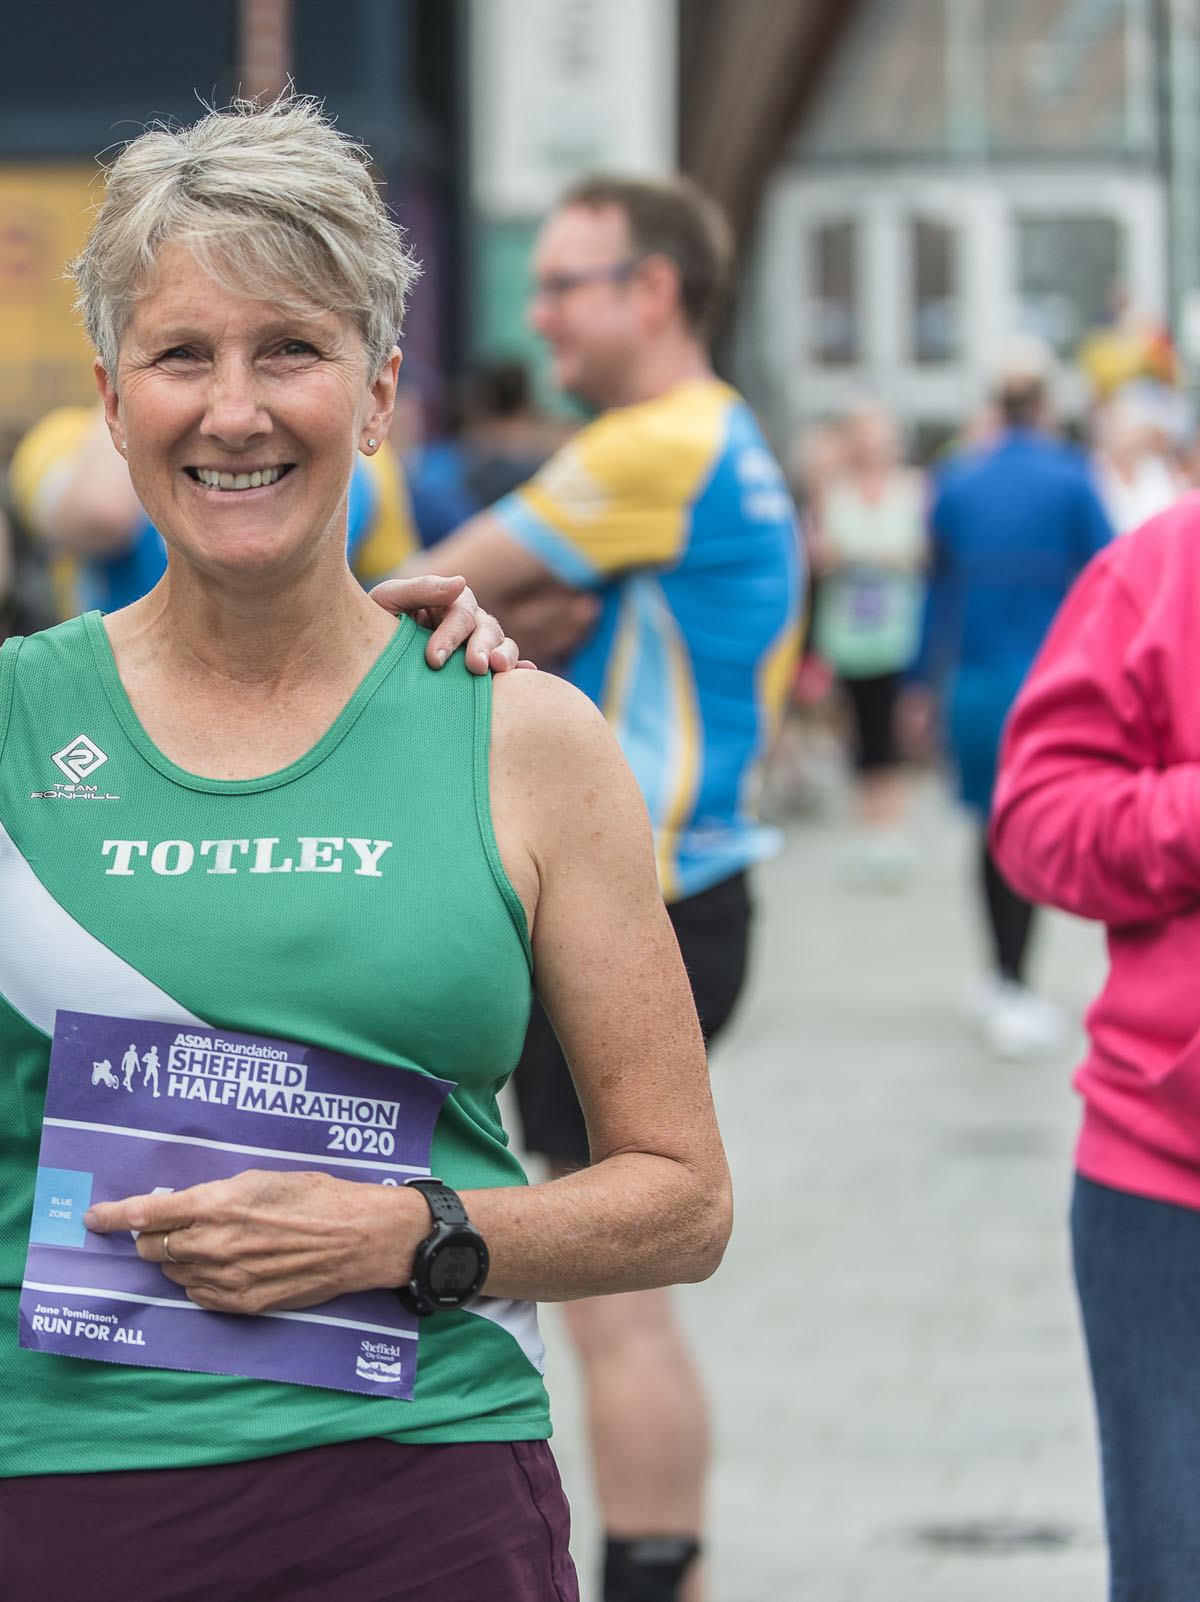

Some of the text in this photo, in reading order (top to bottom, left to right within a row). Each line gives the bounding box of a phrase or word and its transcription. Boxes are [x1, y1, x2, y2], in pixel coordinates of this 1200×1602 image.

[30, 790, 121, 800] RONHILL
[52, 783, 98, 792] TEAM
[101, 837, 393, 877] TOTLEY
[174, 1033, 289, 1062] ASDA Foundation
[171, 1048, 304, 1088] SHEFFIELD
[167, 1074, 396, 1127] HALF MARATHON
[326, 1125, 395, 1157] 2020
[50, 1196, 73, 1207] BLUE
[48, 1209, 72, 1220] ZONE
[35, 1304, 119, 1325] Jane Tomlinson's
[32, 1315, 146, 1346] RUN FOR ALL
[360, 1340, 400, 1357] Sheffield
